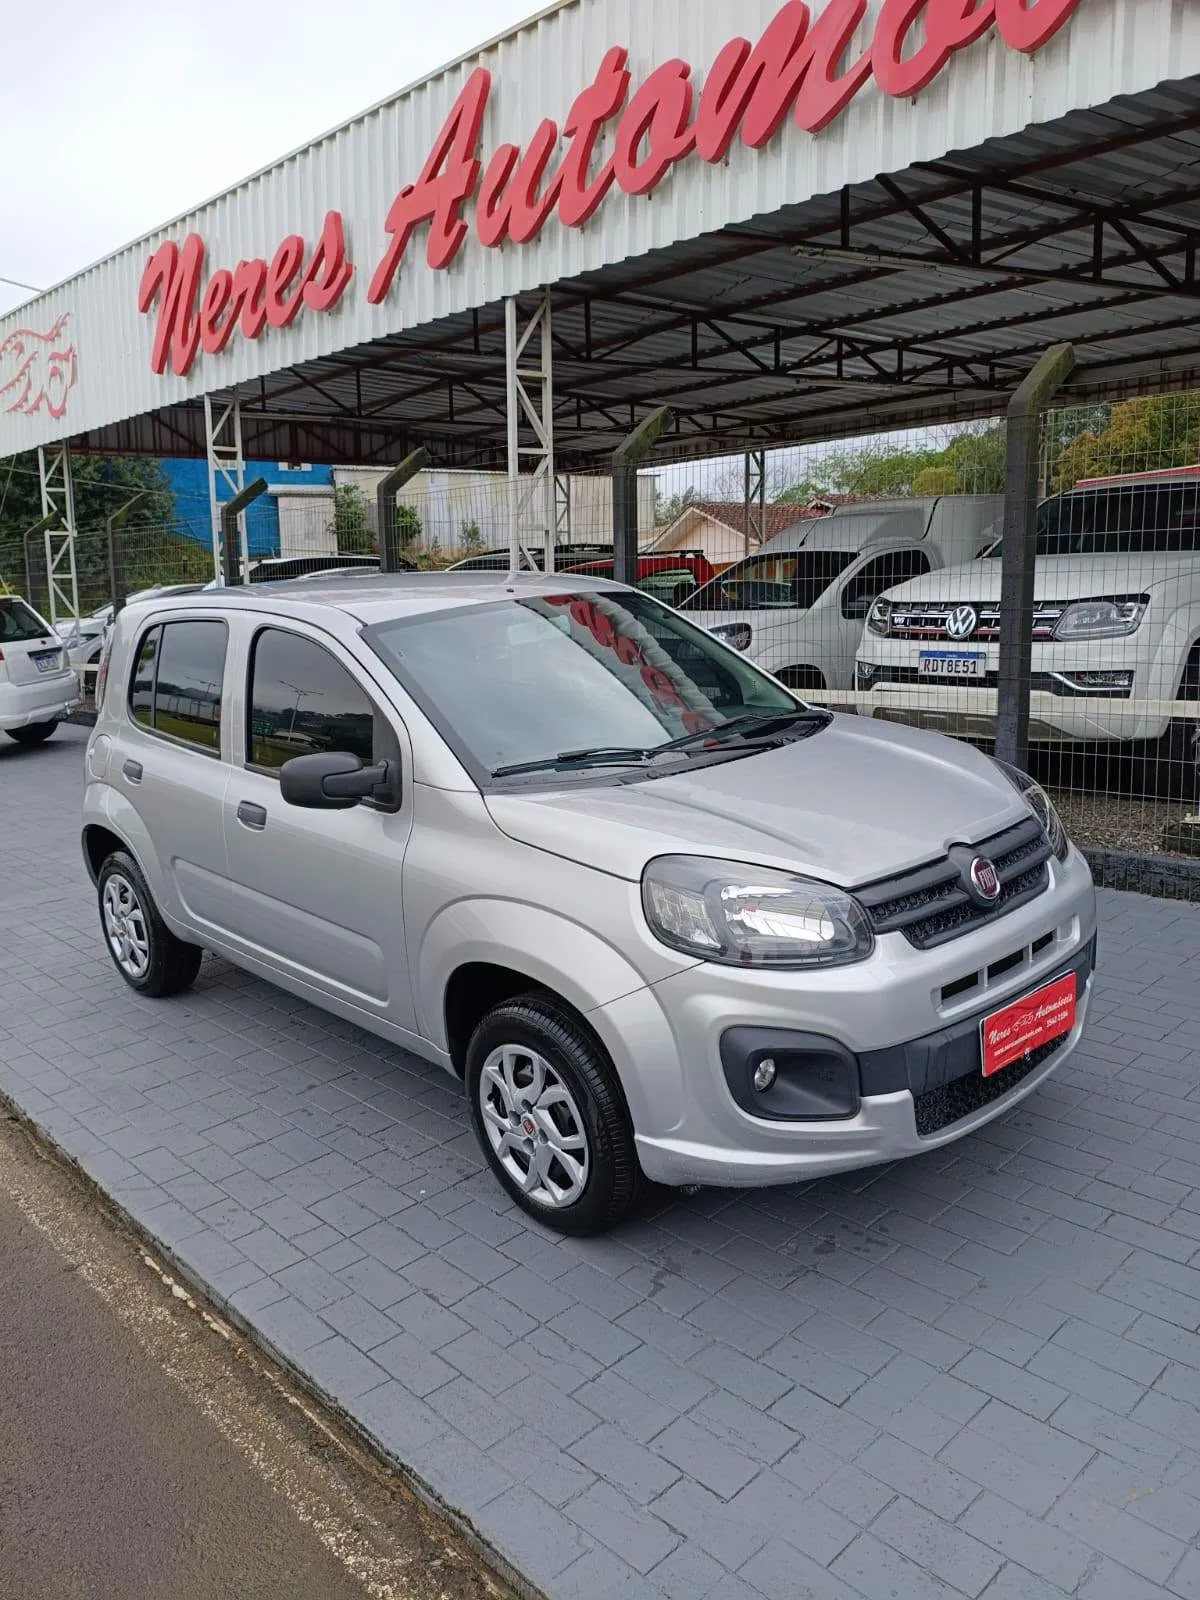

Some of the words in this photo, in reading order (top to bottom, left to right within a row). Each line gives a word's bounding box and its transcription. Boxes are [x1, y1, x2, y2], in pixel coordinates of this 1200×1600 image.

[139, 210, 354, 378] Neres
[893, 616, 906, 625] V6
[923, 658, 977, 675] RDT8E51
[978, 867, 995, 889] FIAT
[989, 1028, 1011, 1044] Neres
